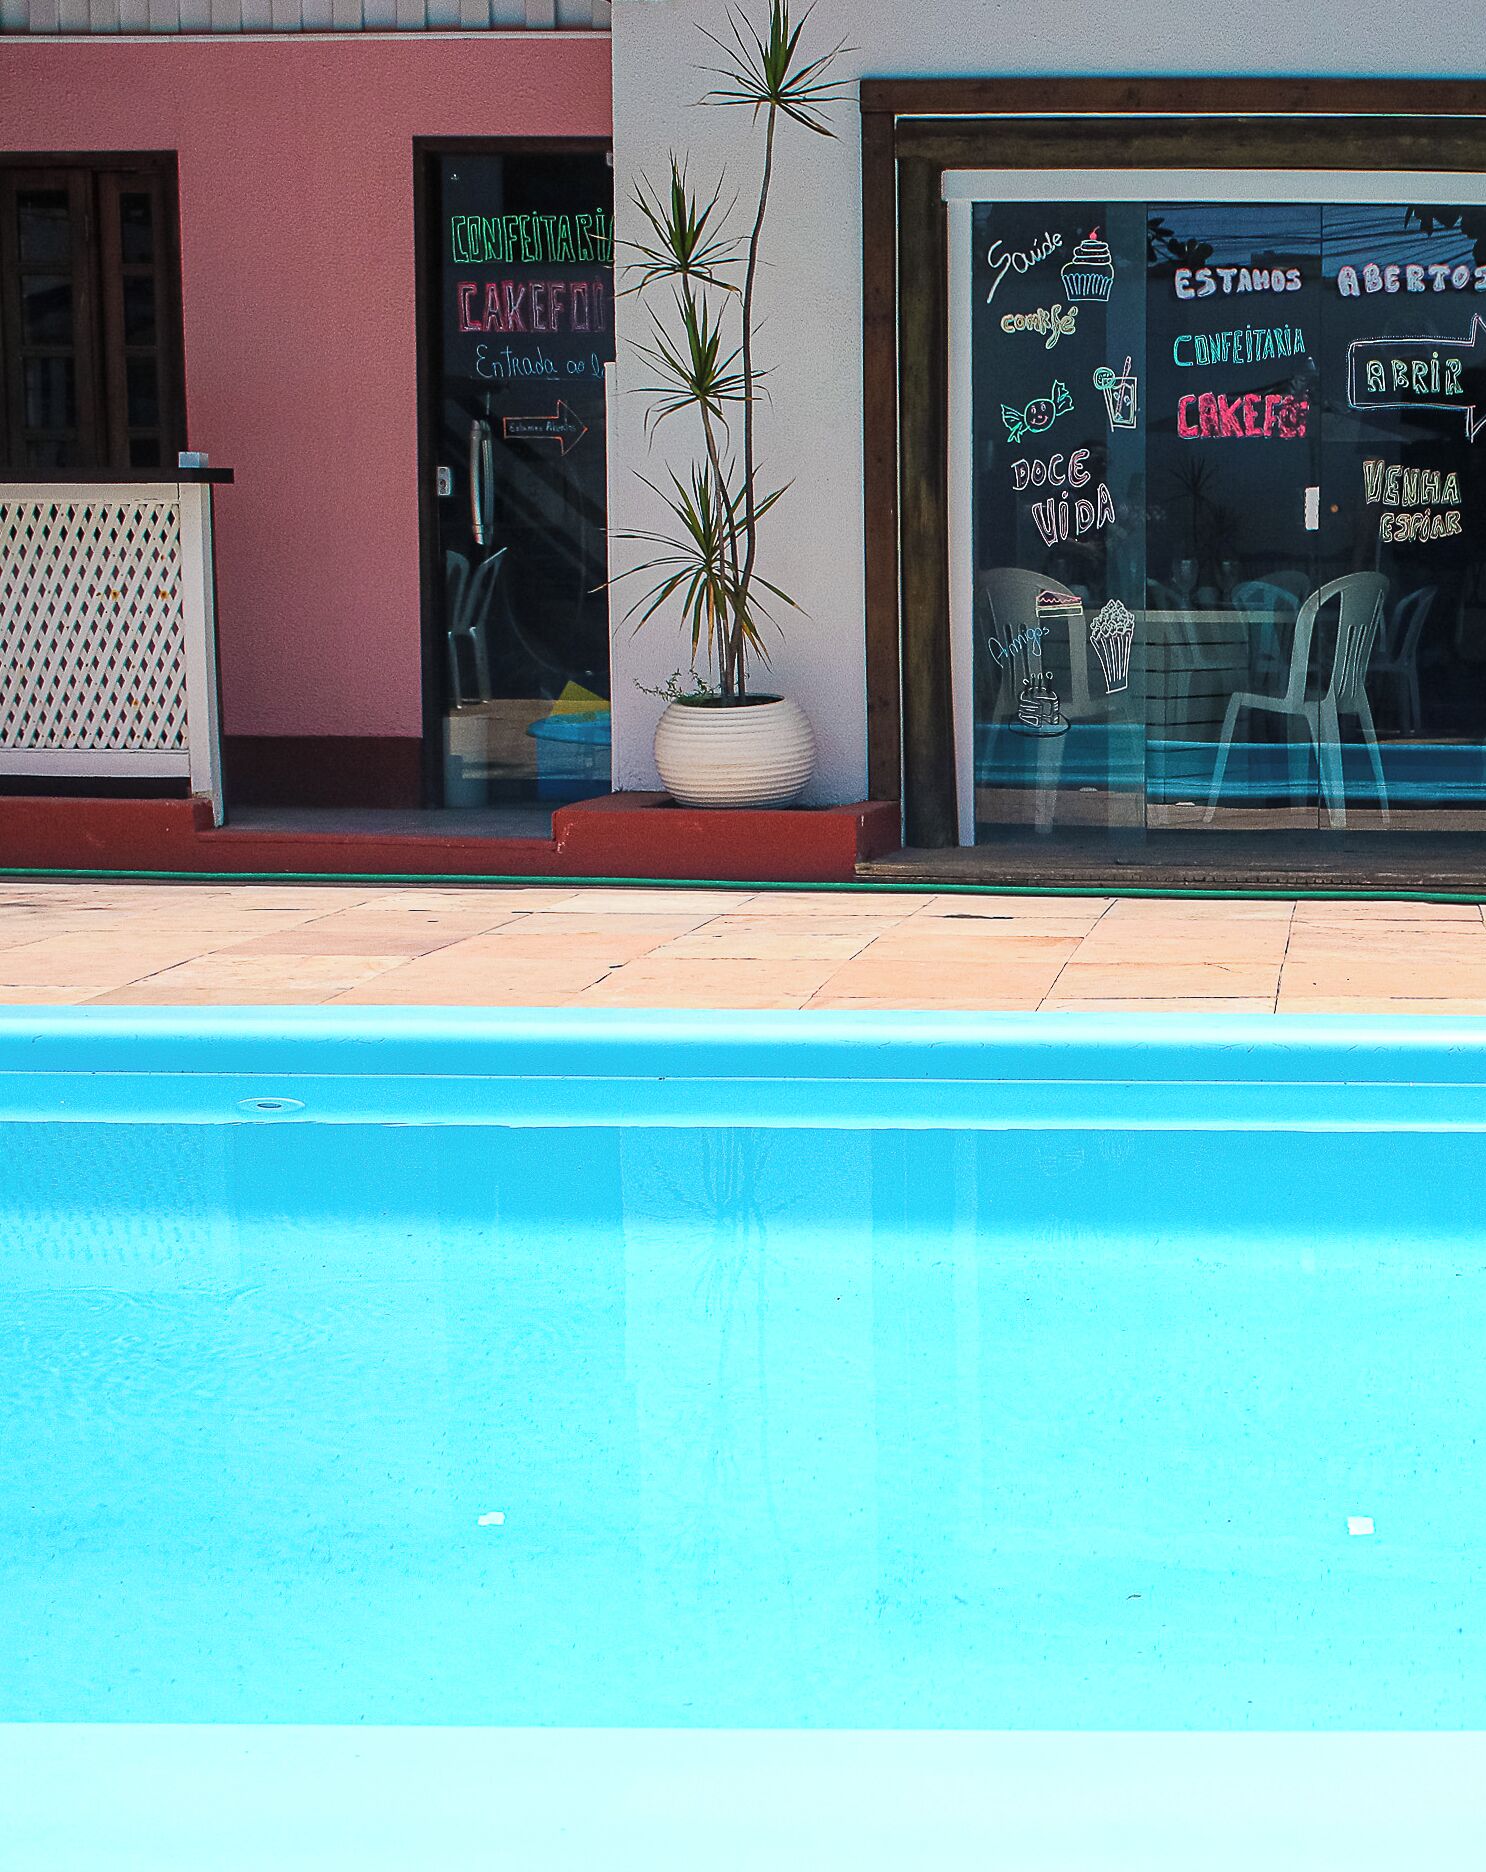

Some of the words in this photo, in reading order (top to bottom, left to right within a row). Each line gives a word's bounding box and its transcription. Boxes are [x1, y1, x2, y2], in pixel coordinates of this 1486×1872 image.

[986, 231, 1063, 303] Saúde
[1175, 267, 1302, 300] ESTAMOS
[476, 344, 557, 379] Entrada
[566, 360, 585, 374] ao
[1173, 325, 1306, 367] CONFEITARIA
[1366, 351, 1464, 395] ABRIR
[1011, 449, 1091, 491] DOCE
[1362, 459, 1463, 506] VENHA
[1032, 482, 1116, 548] VIDA
[987, 624, 1050, 669] Amigos
